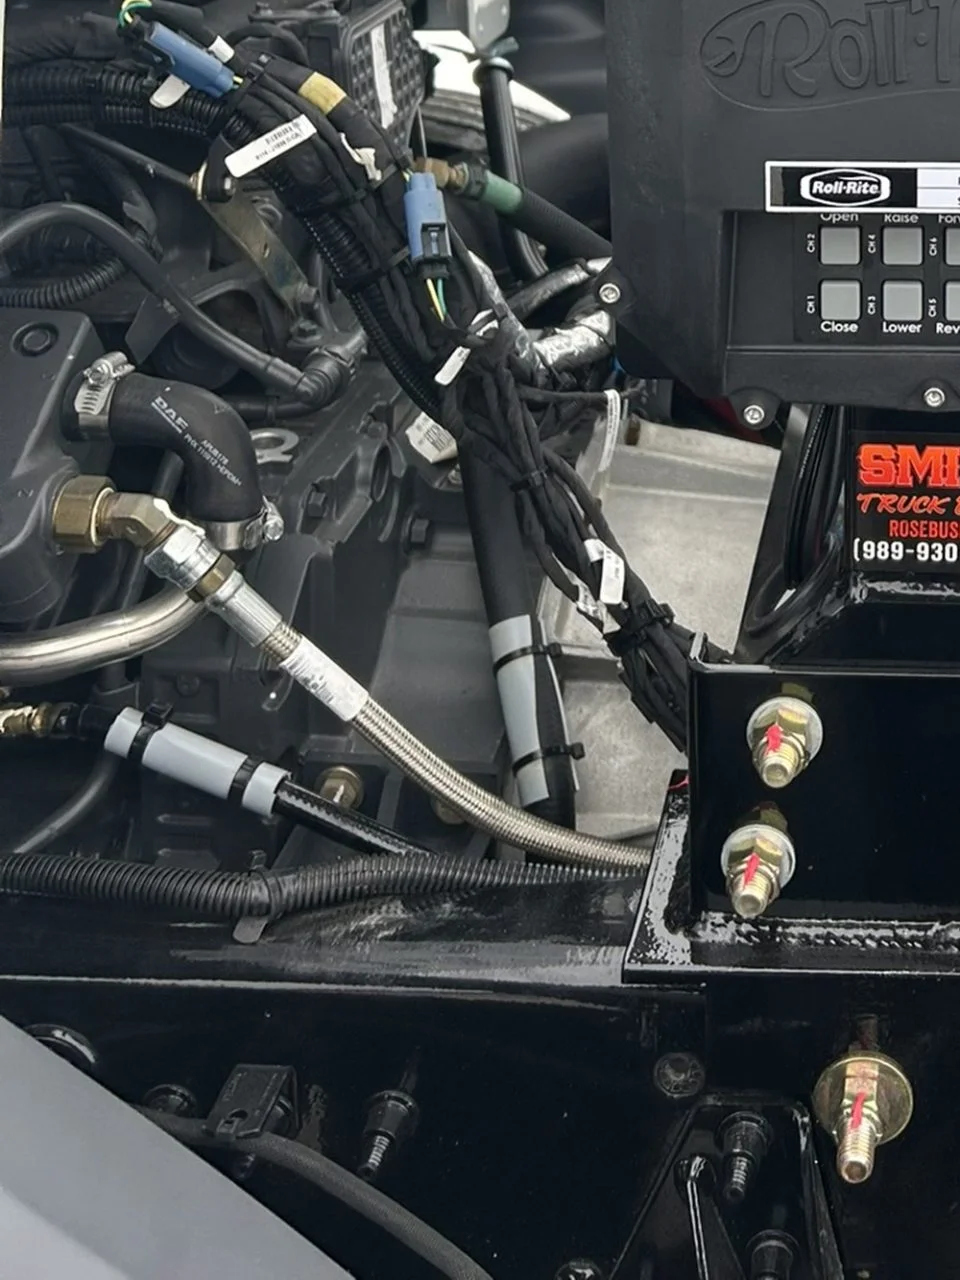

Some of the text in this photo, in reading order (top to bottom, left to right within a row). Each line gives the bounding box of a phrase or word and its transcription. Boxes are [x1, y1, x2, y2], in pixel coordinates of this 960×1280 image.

[807, 240, 815, 252] CH
[868, 242, 876, 253] CH
[929, 244, 937, 256] CH
[807, 302, 815, 314] CH
[868, 303, 876, 315] CH
[928, 306, 936, 317] CH
[820, 321, 858, 333] Close
[882, 322, 922, 334] Lower
[856, 492, 950, 516] TRUCK
